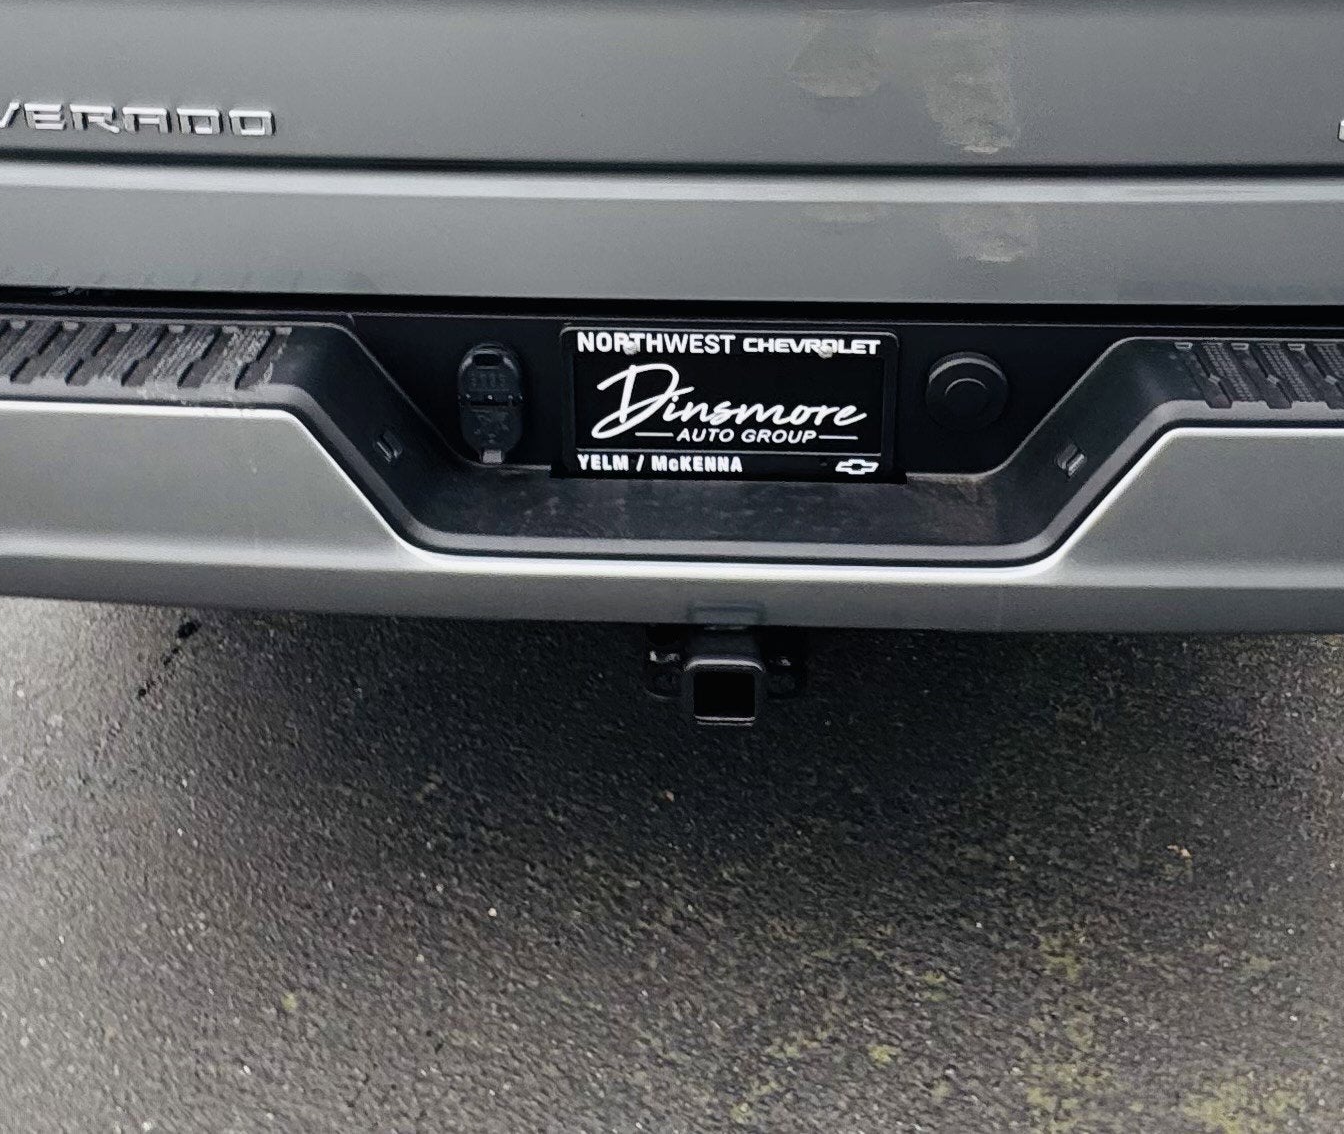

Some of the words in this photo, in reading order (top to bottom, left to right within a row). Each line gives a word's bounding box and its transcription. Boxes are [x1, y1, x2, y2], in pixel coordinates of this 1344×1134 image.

[576, 331, 736, 355] NORTHWEST
[742, 337, 881, 356] CHEVROLET
[590, 362, 868, 440] Dinsmore
[675, 427, 735, 443] AUTO
[740, 428, 818, 444] GROUP
[577, 453, 630, 472] YELM
[650, 454, 744, 473] McKENNA
